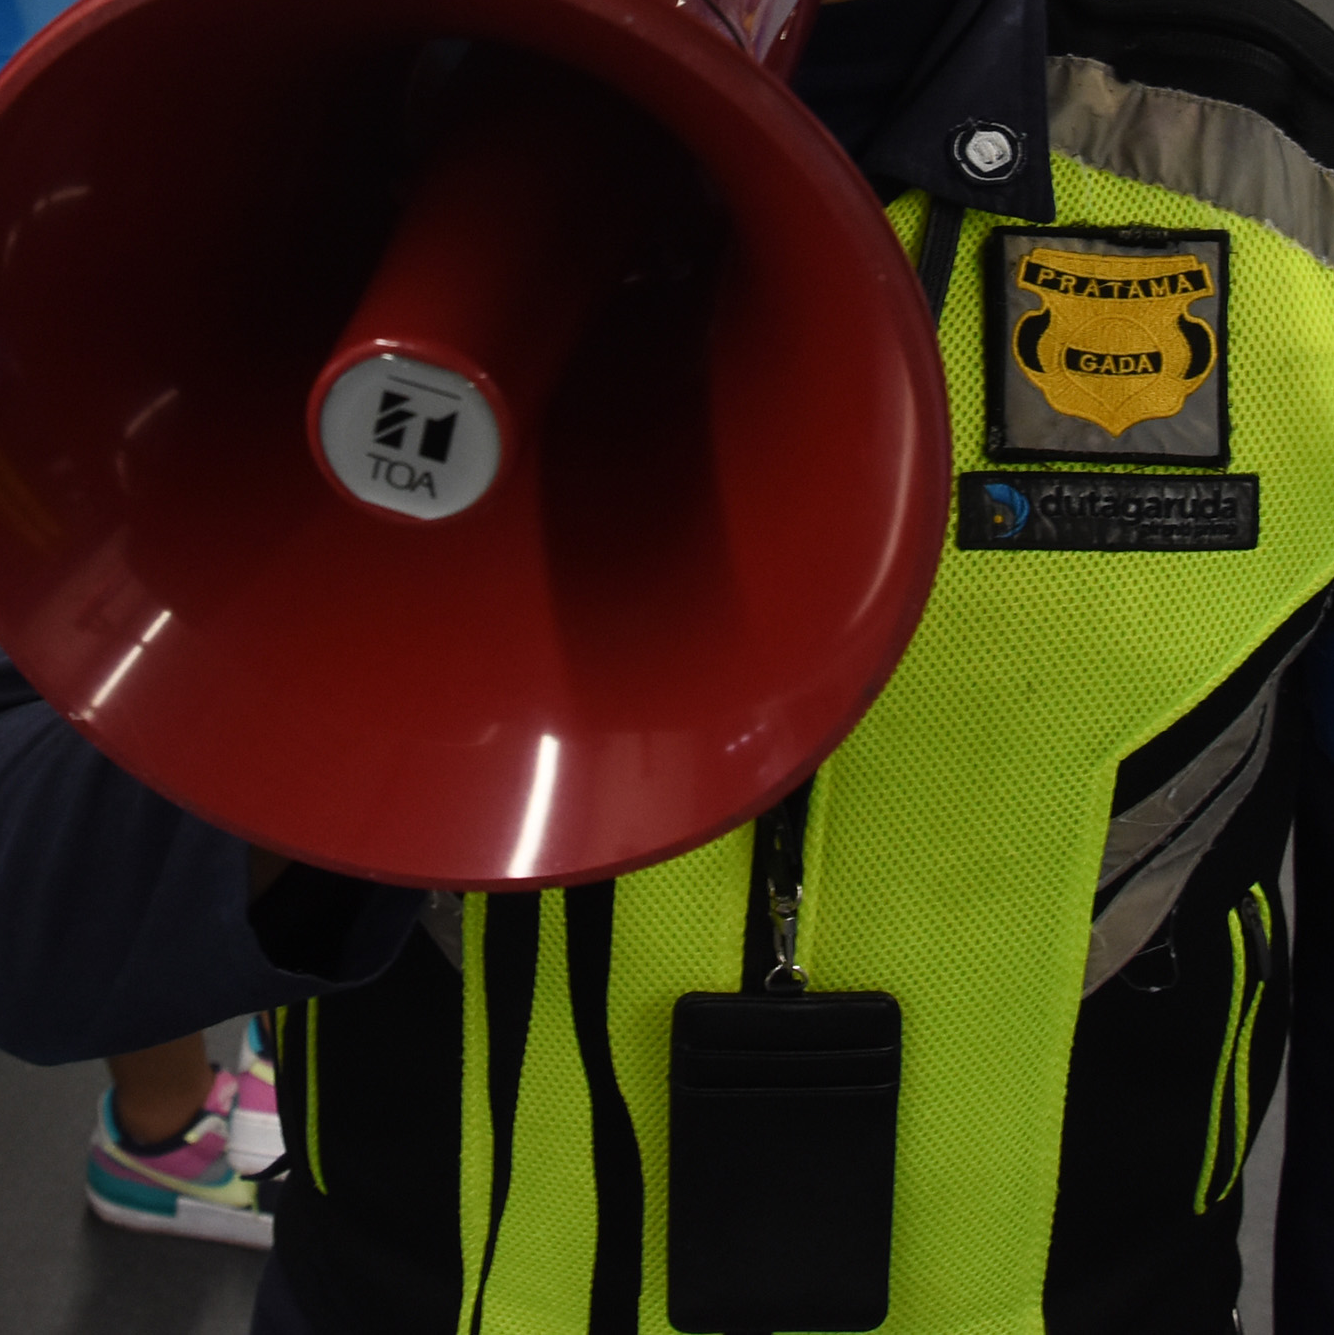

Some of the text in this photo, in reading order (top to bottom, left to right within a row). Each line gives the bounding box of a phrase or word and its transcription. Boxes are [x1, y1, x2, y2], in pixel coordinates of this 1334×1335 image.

[1036, 267, 1192, 300] PRATAMA
[1078, 352, 1154, 375] GADA
[366, 452, 437, 500] TOA
[1039, 481, 1238, 526] dutagaruda
